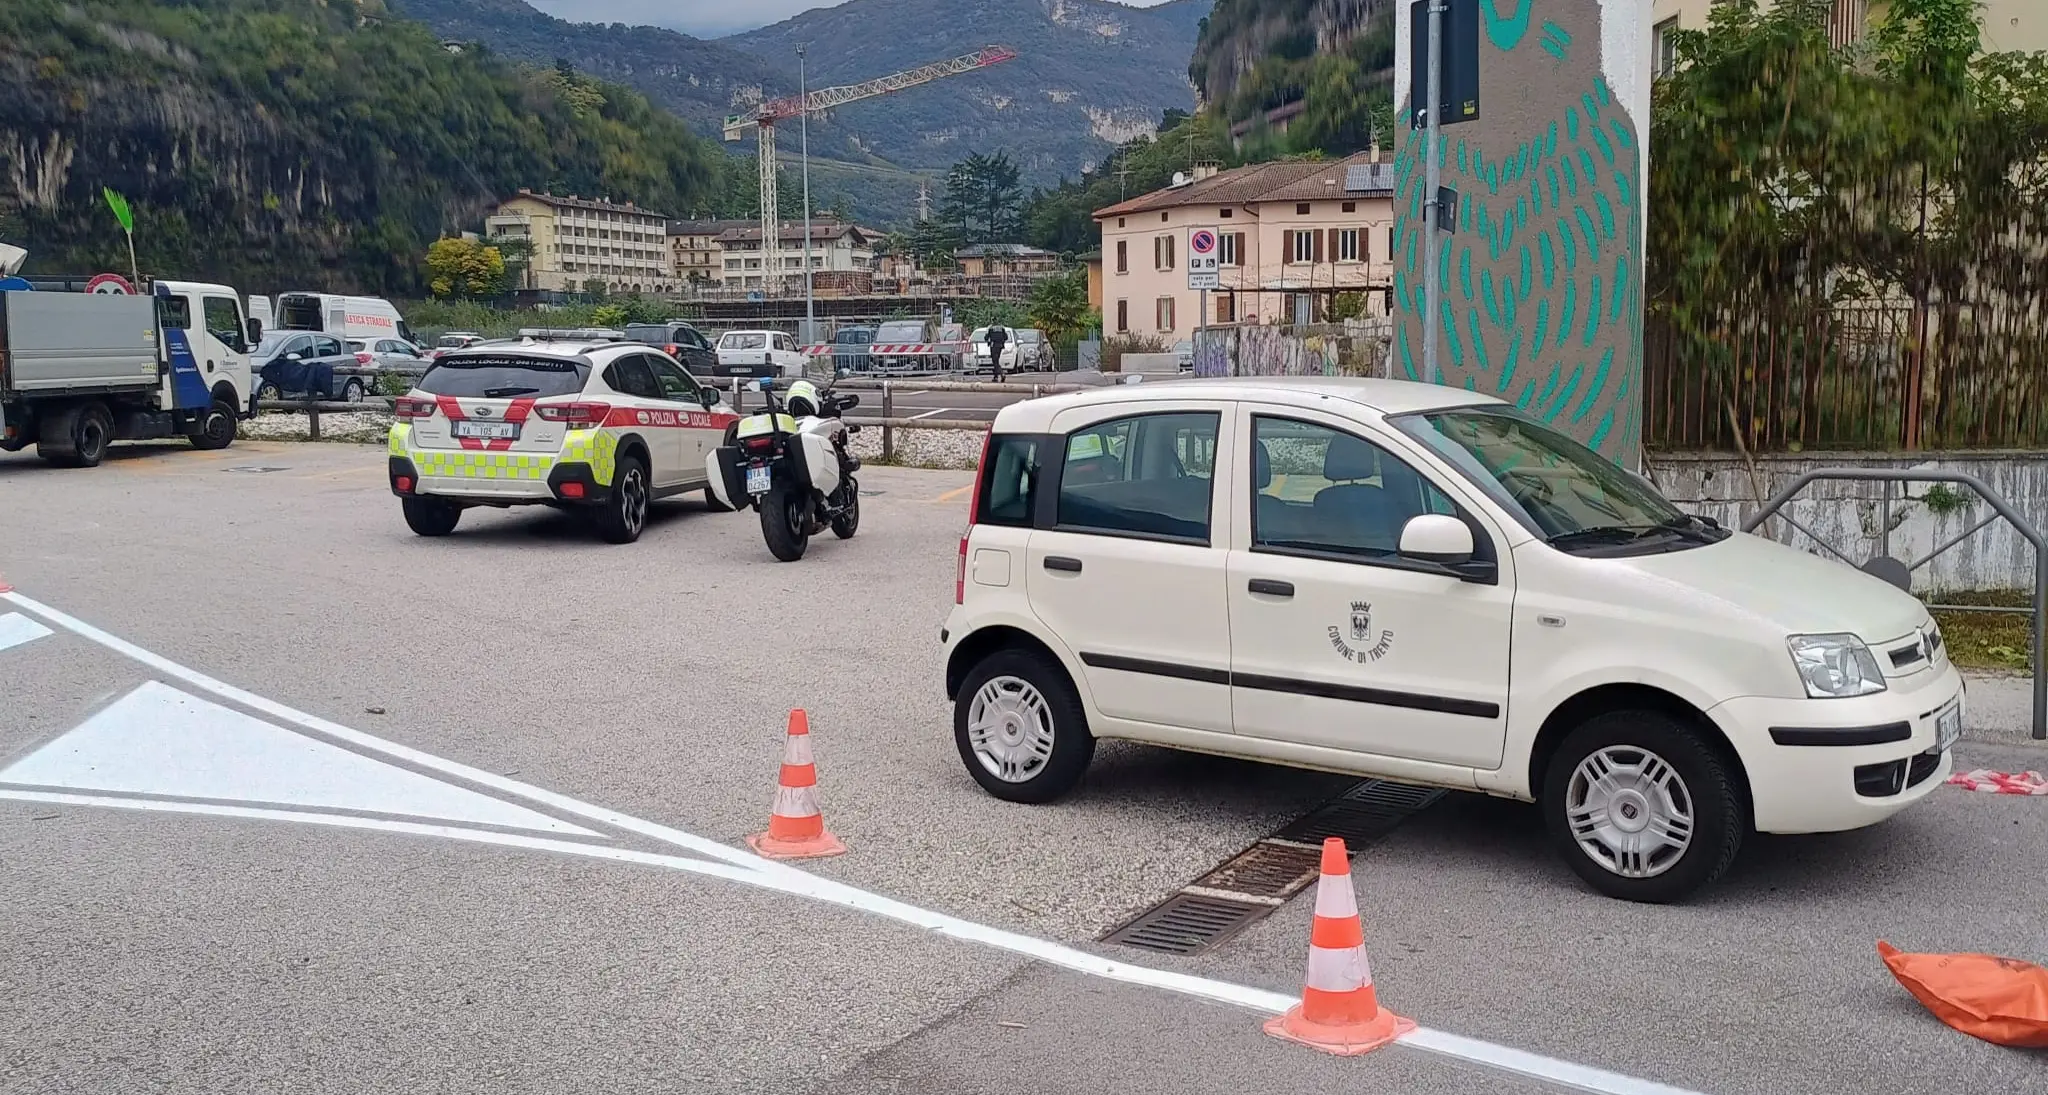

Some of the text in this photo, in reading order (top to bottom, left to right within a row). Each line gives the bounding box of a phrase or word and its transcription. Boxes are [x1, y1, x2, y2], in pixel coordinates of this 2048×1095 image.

[366, 316, 392, 328] STRADALE
[650, 411, 711, 427] POLIZIA LOCALE
[462, 426, 471, 435] YA
[500, 427, 509, 436] AV
[1328, 625, 1394, 664] COMUNE DI TRENTO
